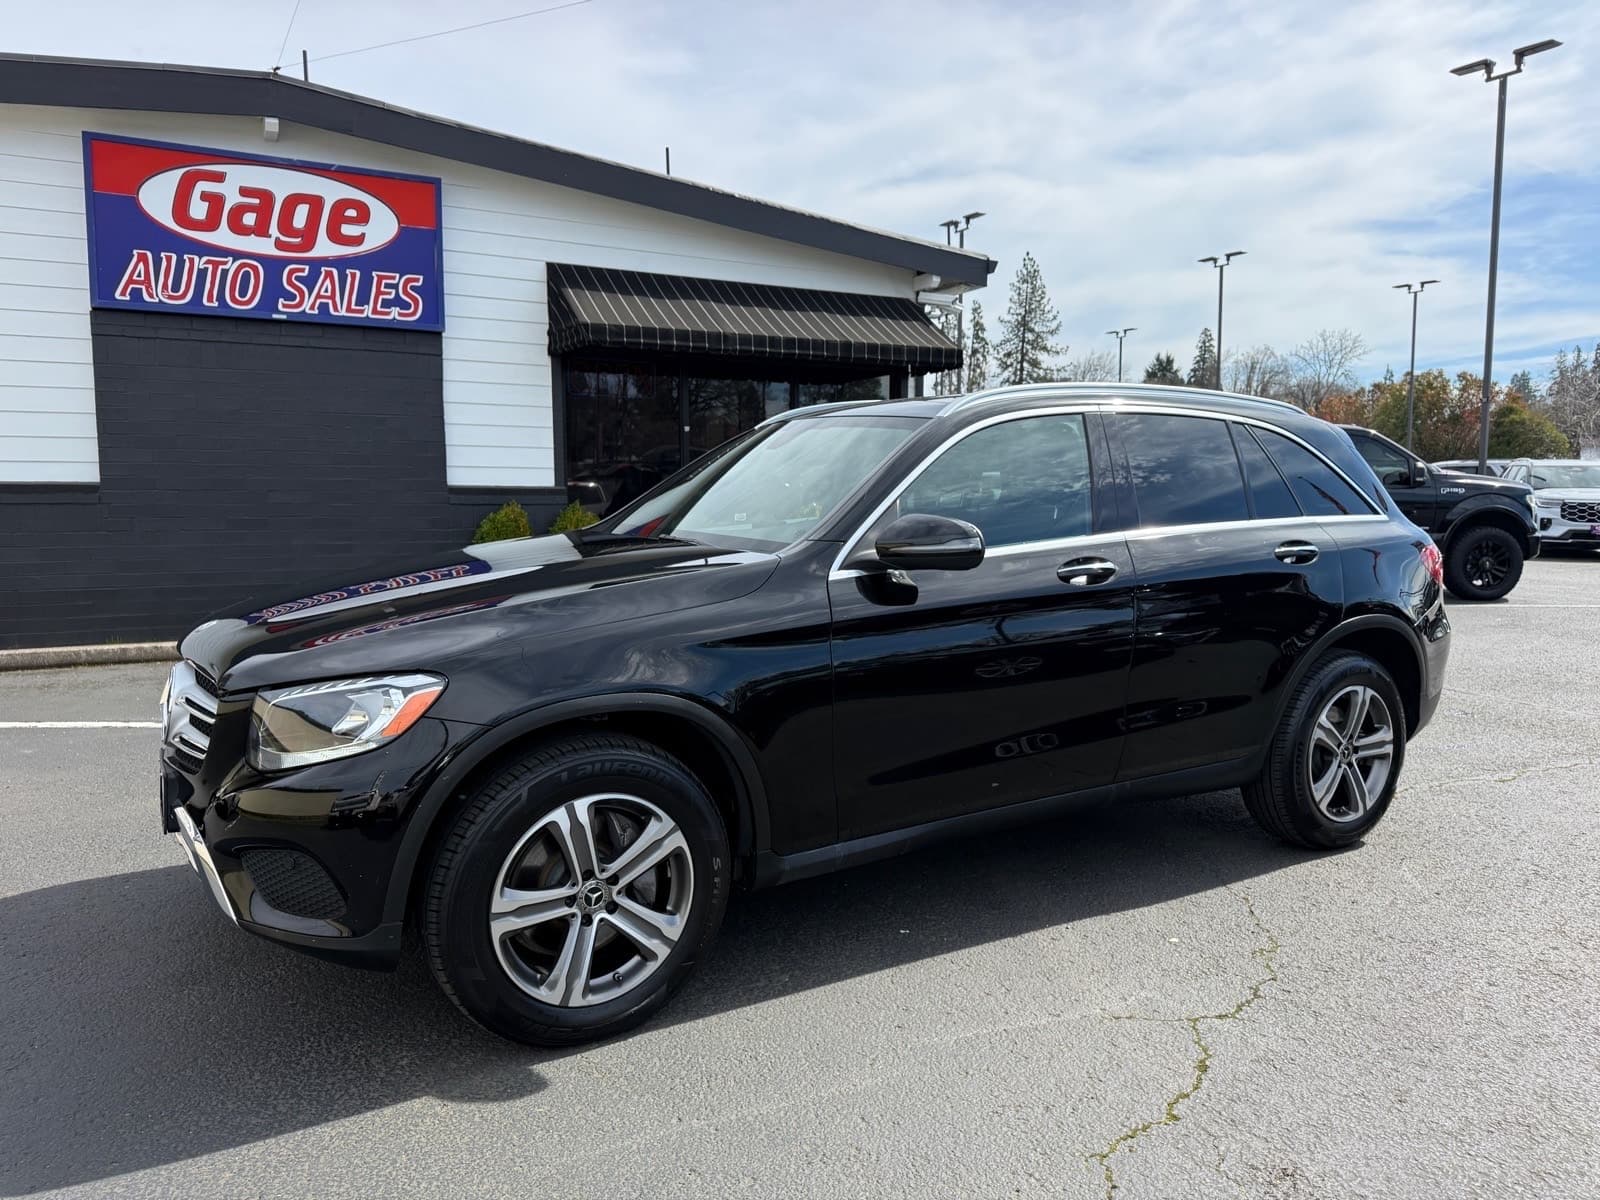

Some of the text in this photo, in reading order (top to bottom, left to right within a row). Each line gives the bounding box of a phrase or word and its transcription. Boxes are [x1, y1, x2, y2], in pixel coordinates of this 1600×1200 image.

[172, 168, 371, 254] Gage
[115, 250, 423, 321] AUTO SALES
